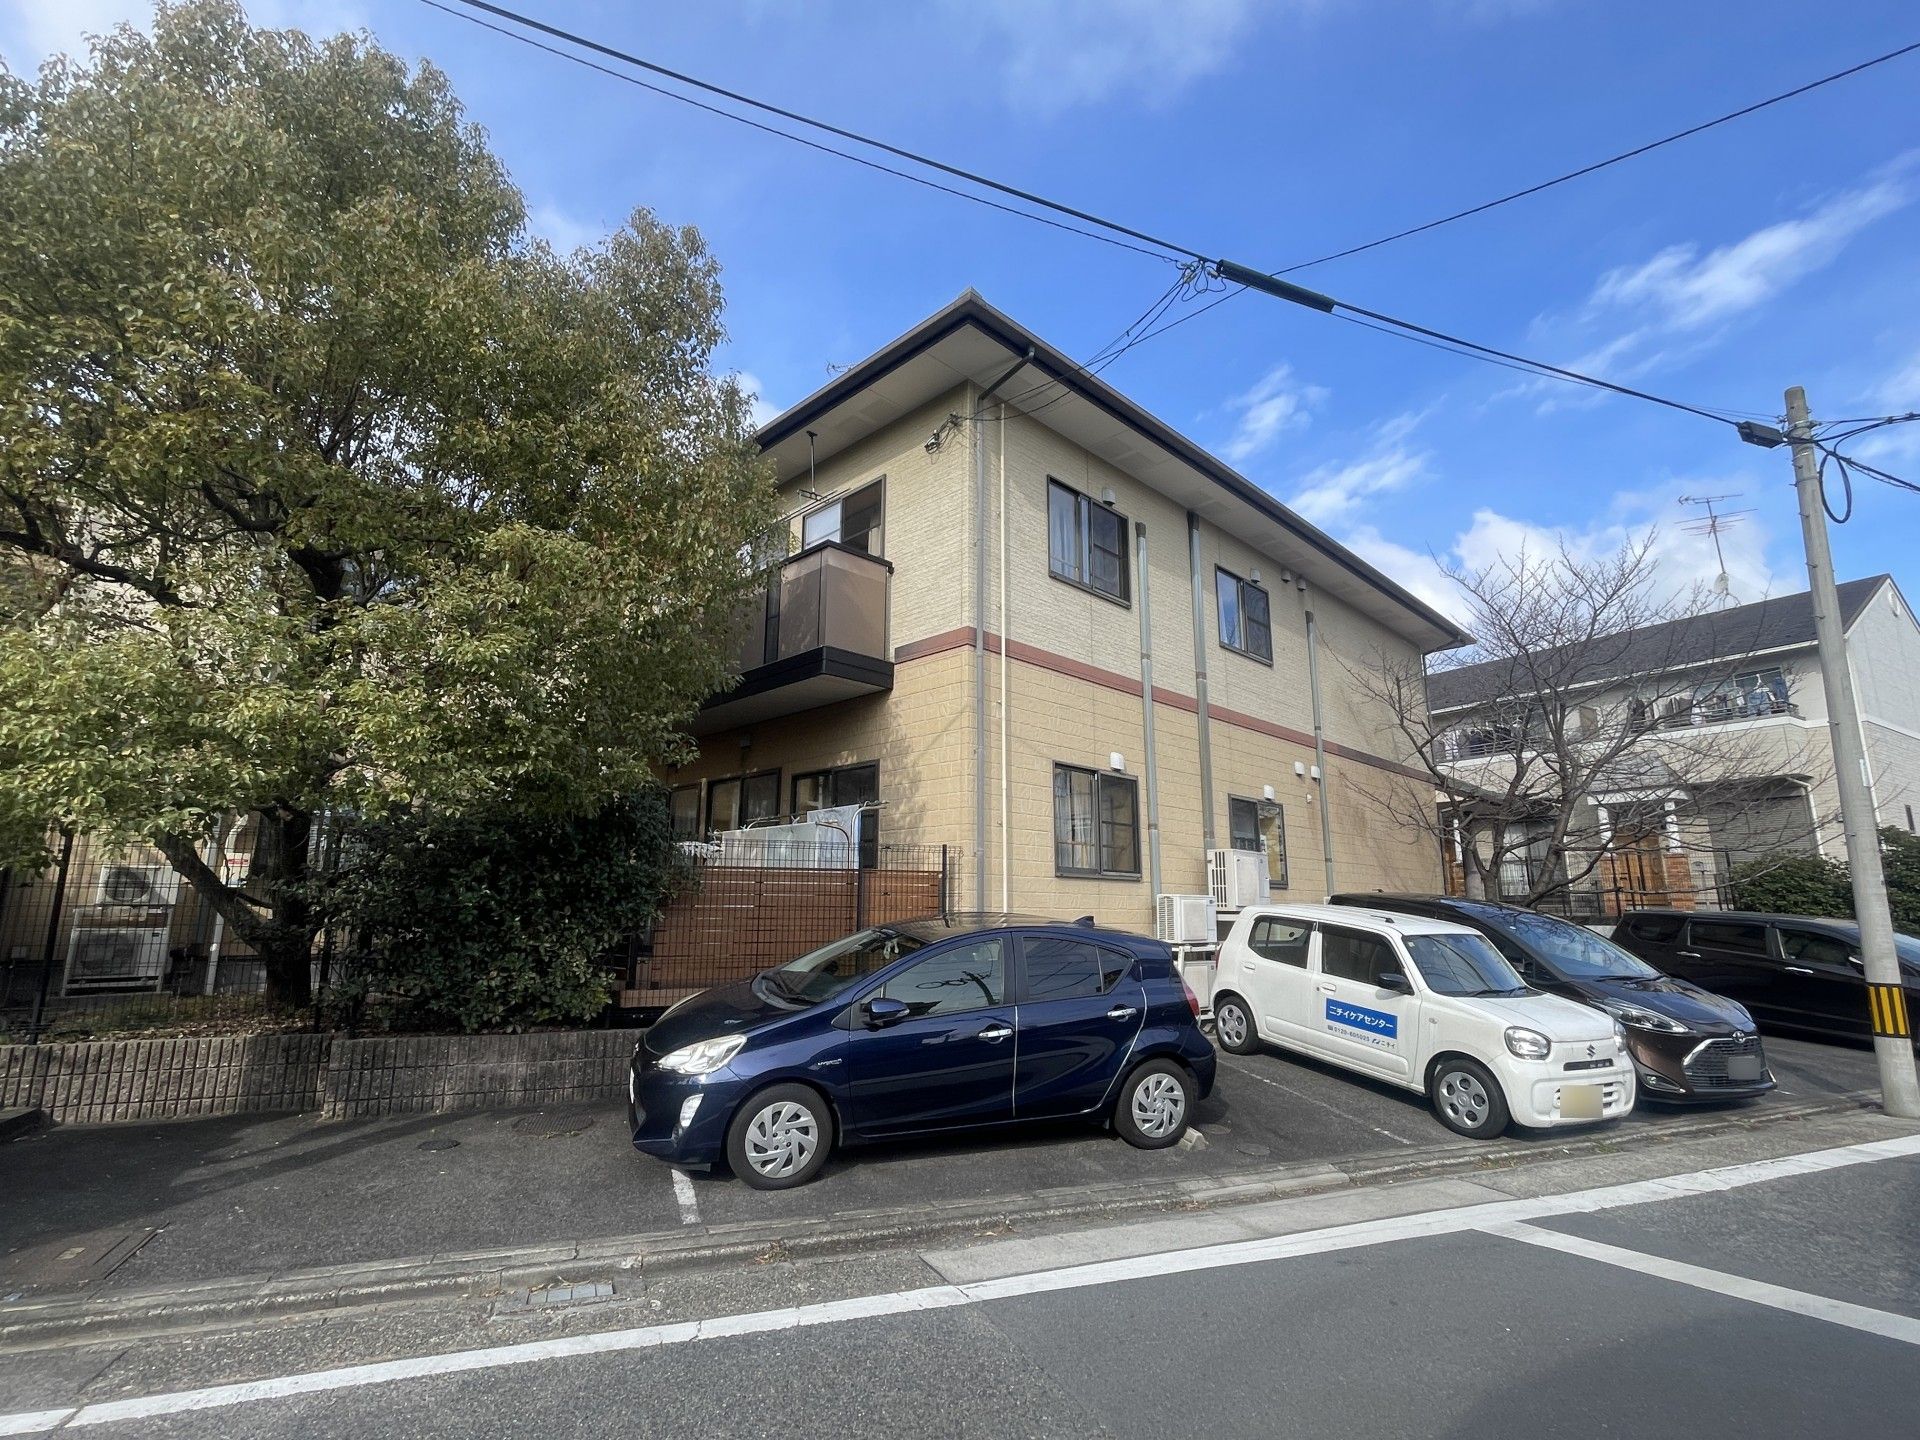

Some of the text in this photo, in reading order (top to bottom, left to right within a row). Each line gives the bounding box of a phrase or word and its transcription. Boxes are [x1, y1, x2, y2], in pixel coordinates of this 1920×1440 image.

[1329, 1006, 1394, 1028] ニチイケアセンター
